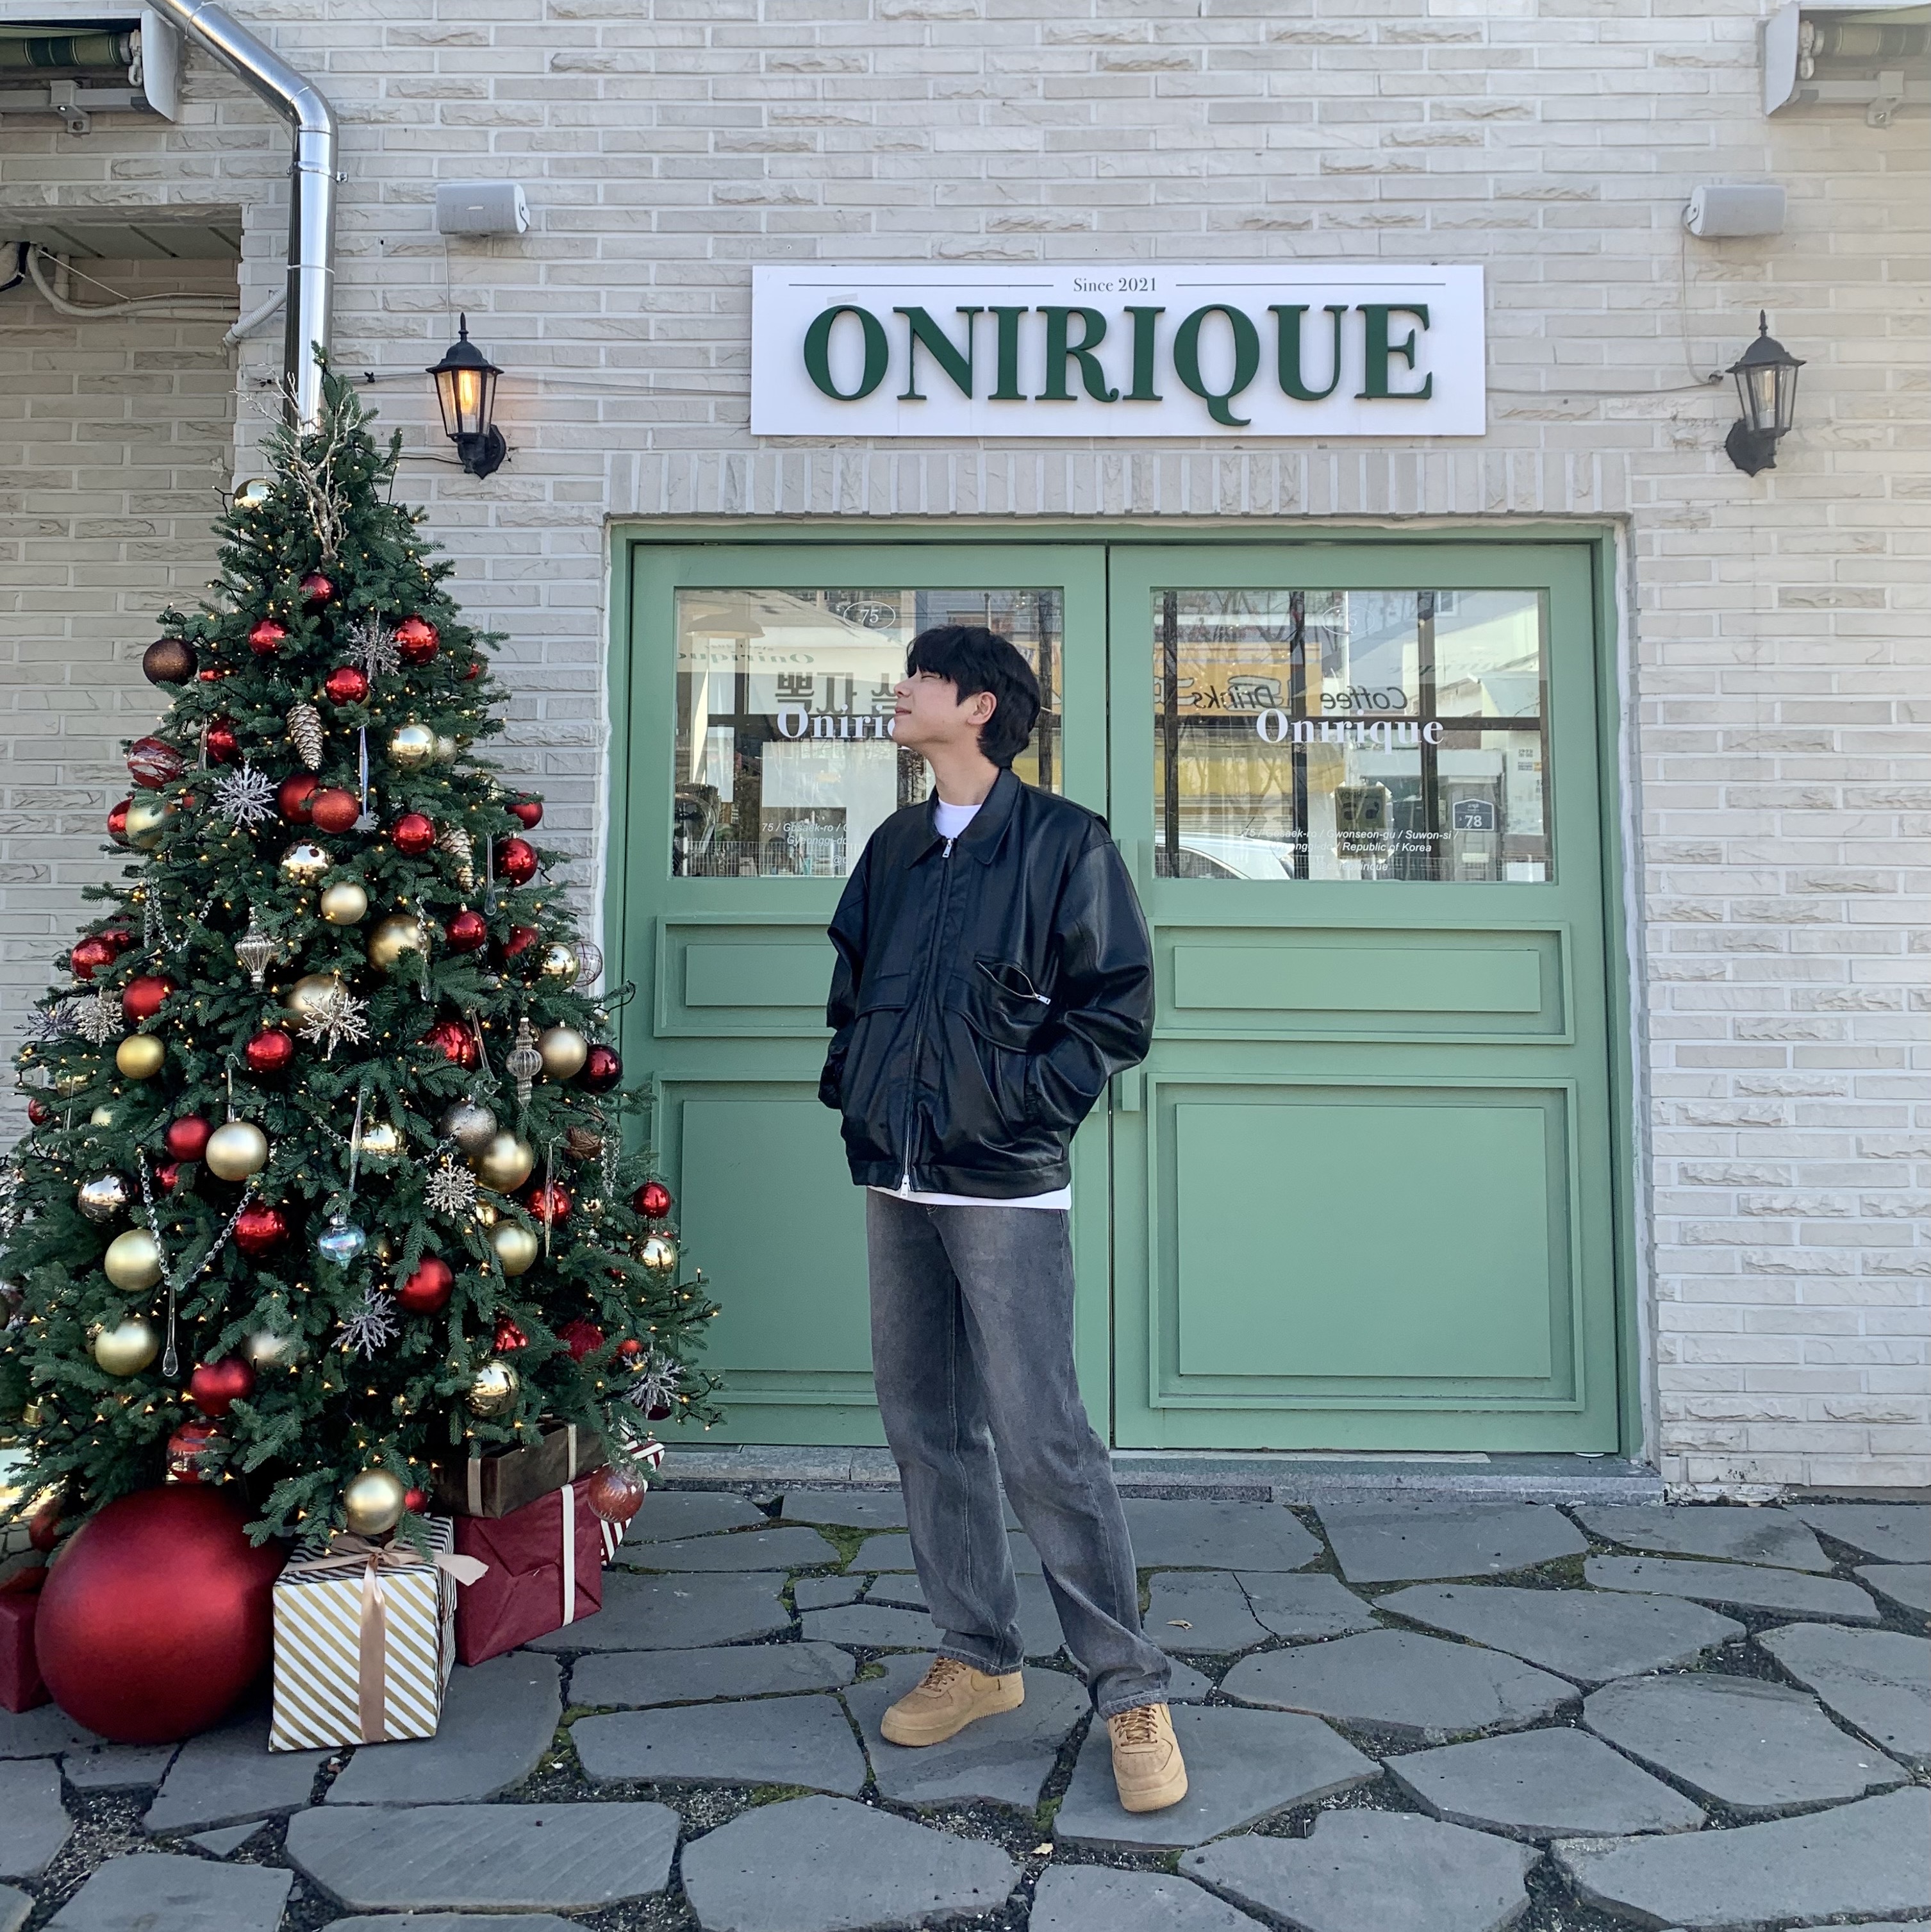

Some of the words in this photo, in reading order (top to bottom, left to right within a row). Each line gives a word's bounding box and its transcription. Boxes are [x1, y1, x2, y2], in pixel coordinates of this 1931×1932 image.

[1073, 277, 1114, 292] Since
[1118, 277, 1157, 292] 2021
[803, 303, 1433, 426] ONIRIQUE
[859, 609, 879, 624] 75
[777, 703, 897, 739] Oniri
[1256, 708, 1444, 755] Onirique
[762, 823, 774, 832] 75
[783, 823, 834, 832] Gosaek-ro
[1464, 814, 1483, 828] 78
[1327, 829, 1396, 840] Gwonseon-gu
[1405, 829, 1452, 840] Suwon-si
[1342, 842, 1387, 853] Republic
[1389, 842, 1400, 851] of
[1402, 842, 1432, 852] Korea
